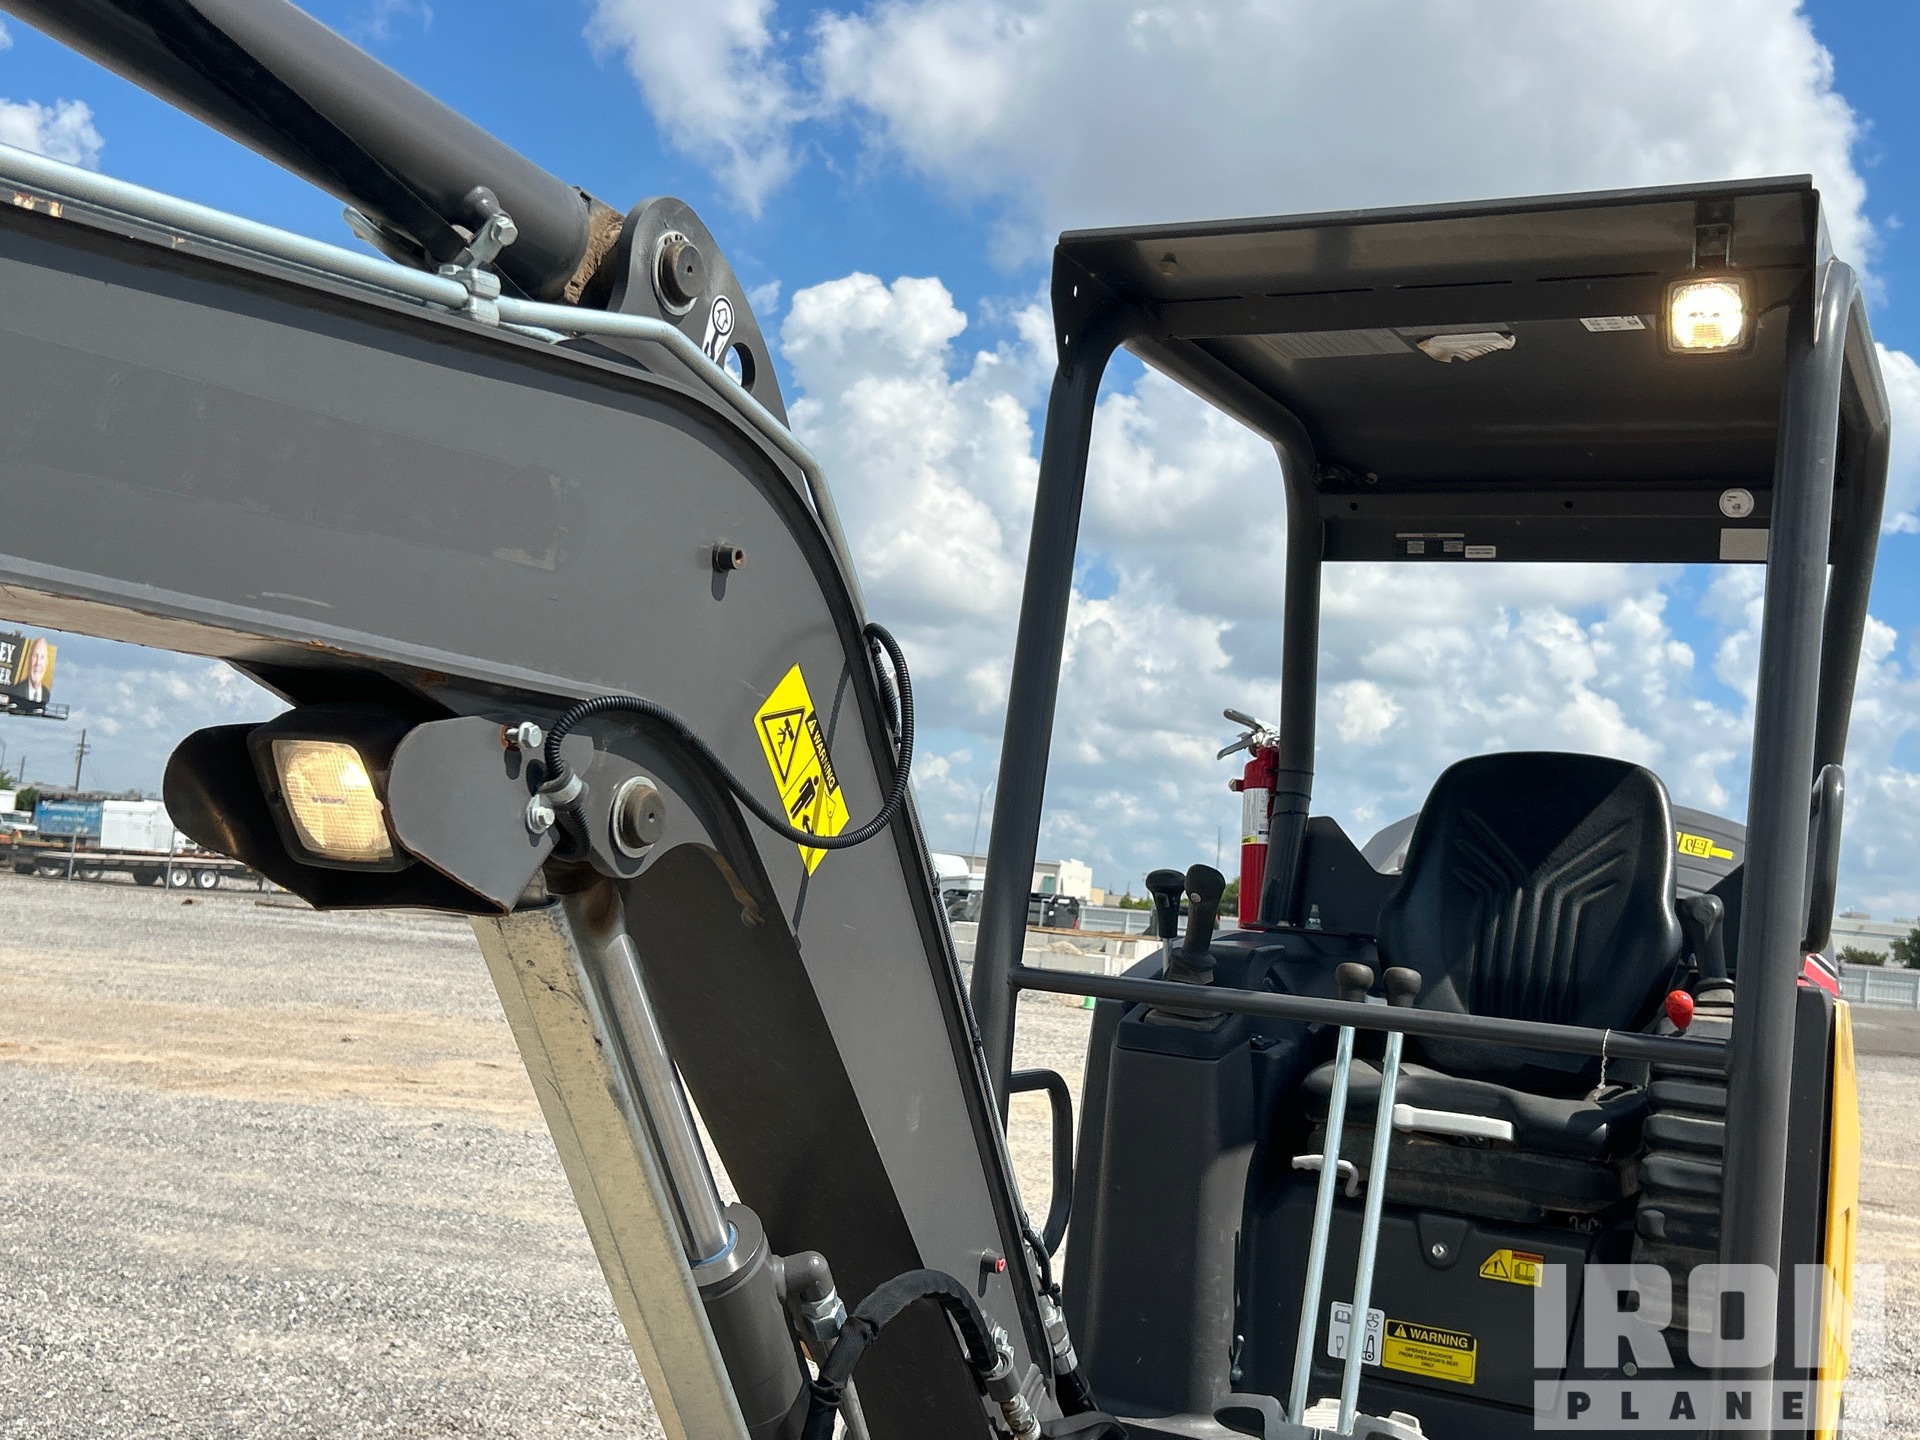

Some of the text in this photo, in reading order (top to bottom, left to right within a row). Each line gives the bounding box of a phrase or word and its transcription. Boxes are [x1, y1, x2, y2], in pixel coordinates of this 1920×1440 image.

[813, 729, 836, 790] WARNING
[1409, 1327, 1468, 1348] WARNING
[1405, 1346, 1427, 1355] OPERATE
